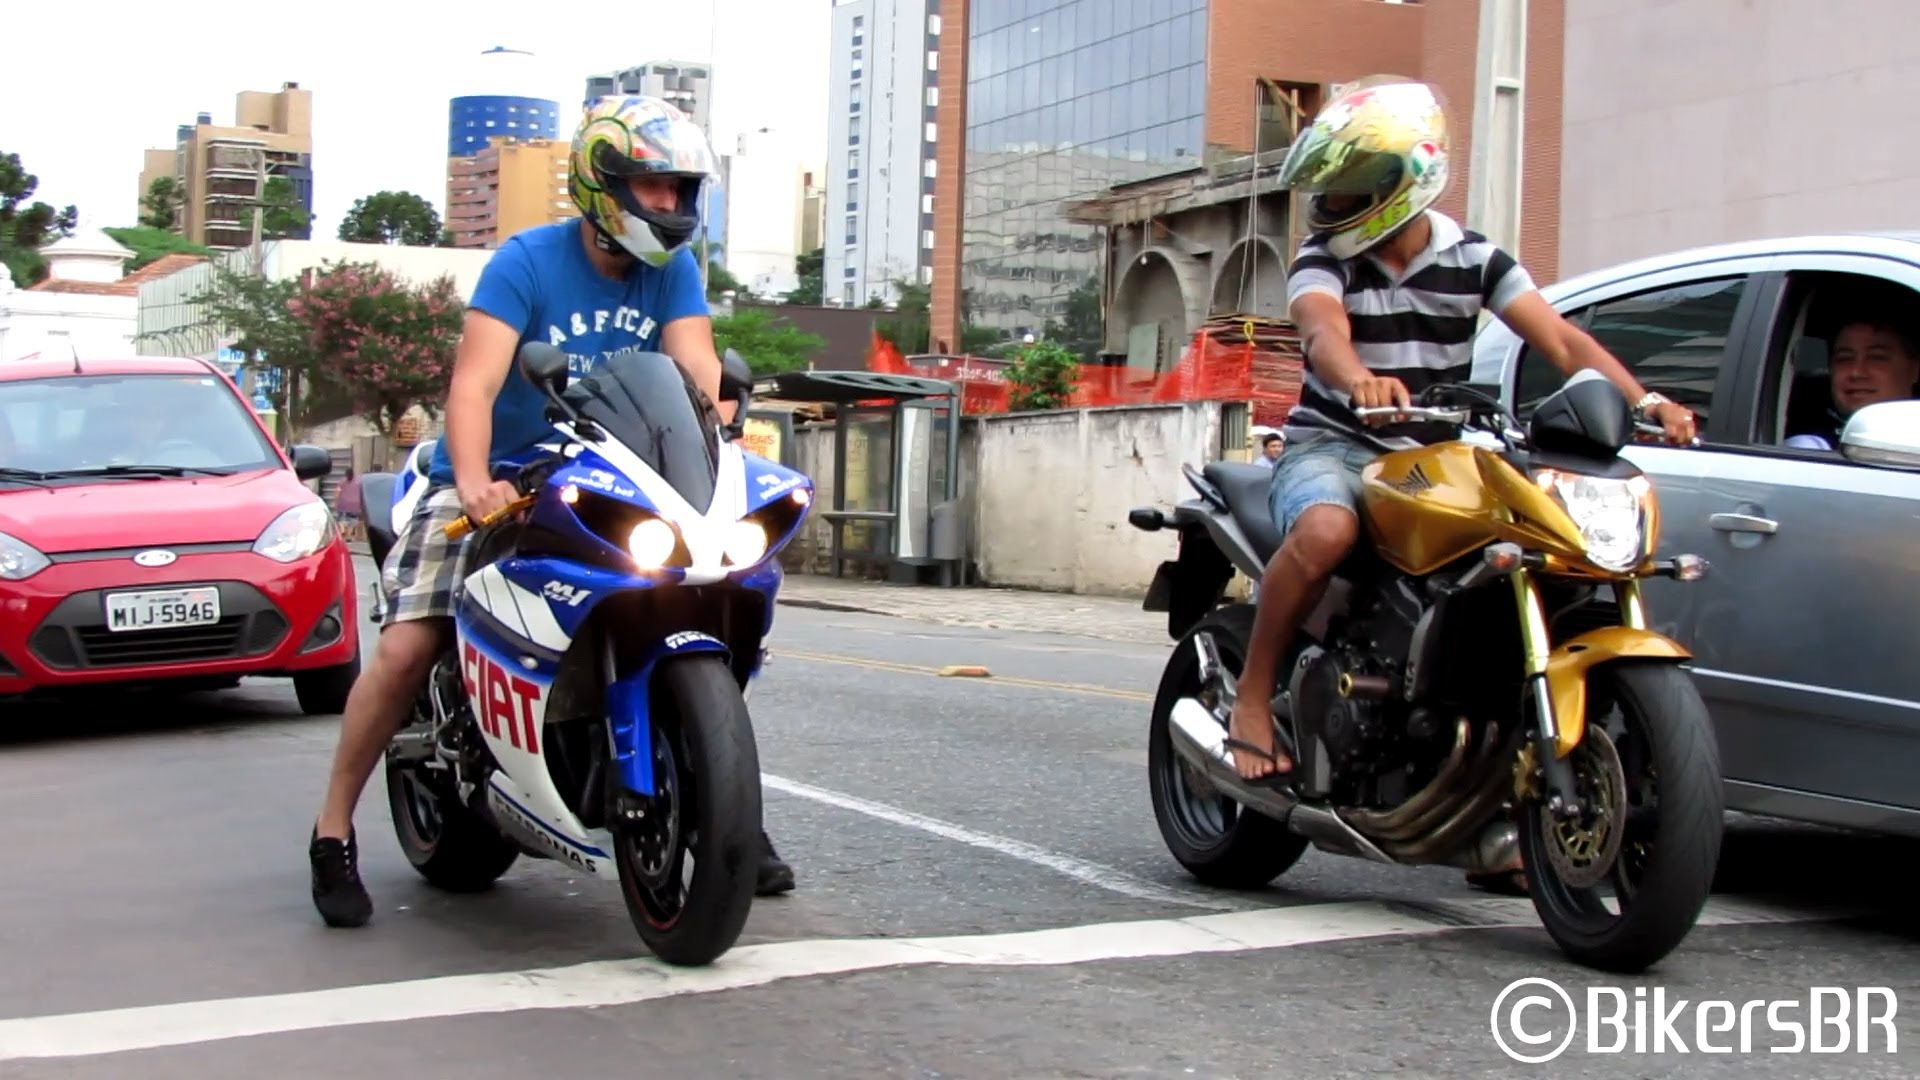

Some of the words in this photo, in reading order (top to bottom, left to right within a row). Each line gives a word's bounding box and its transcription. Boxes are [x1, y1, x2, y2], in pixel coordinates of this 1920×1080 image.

[549, 324, 567, 346] A
[570, 312, 587, 336] &
[594, 305, 657, 340] FTCH
[568, 352, 596, 373] EW
[113, 602, 214, 627] MIJ-5946
[464, 640, 541, 755] FIAT
